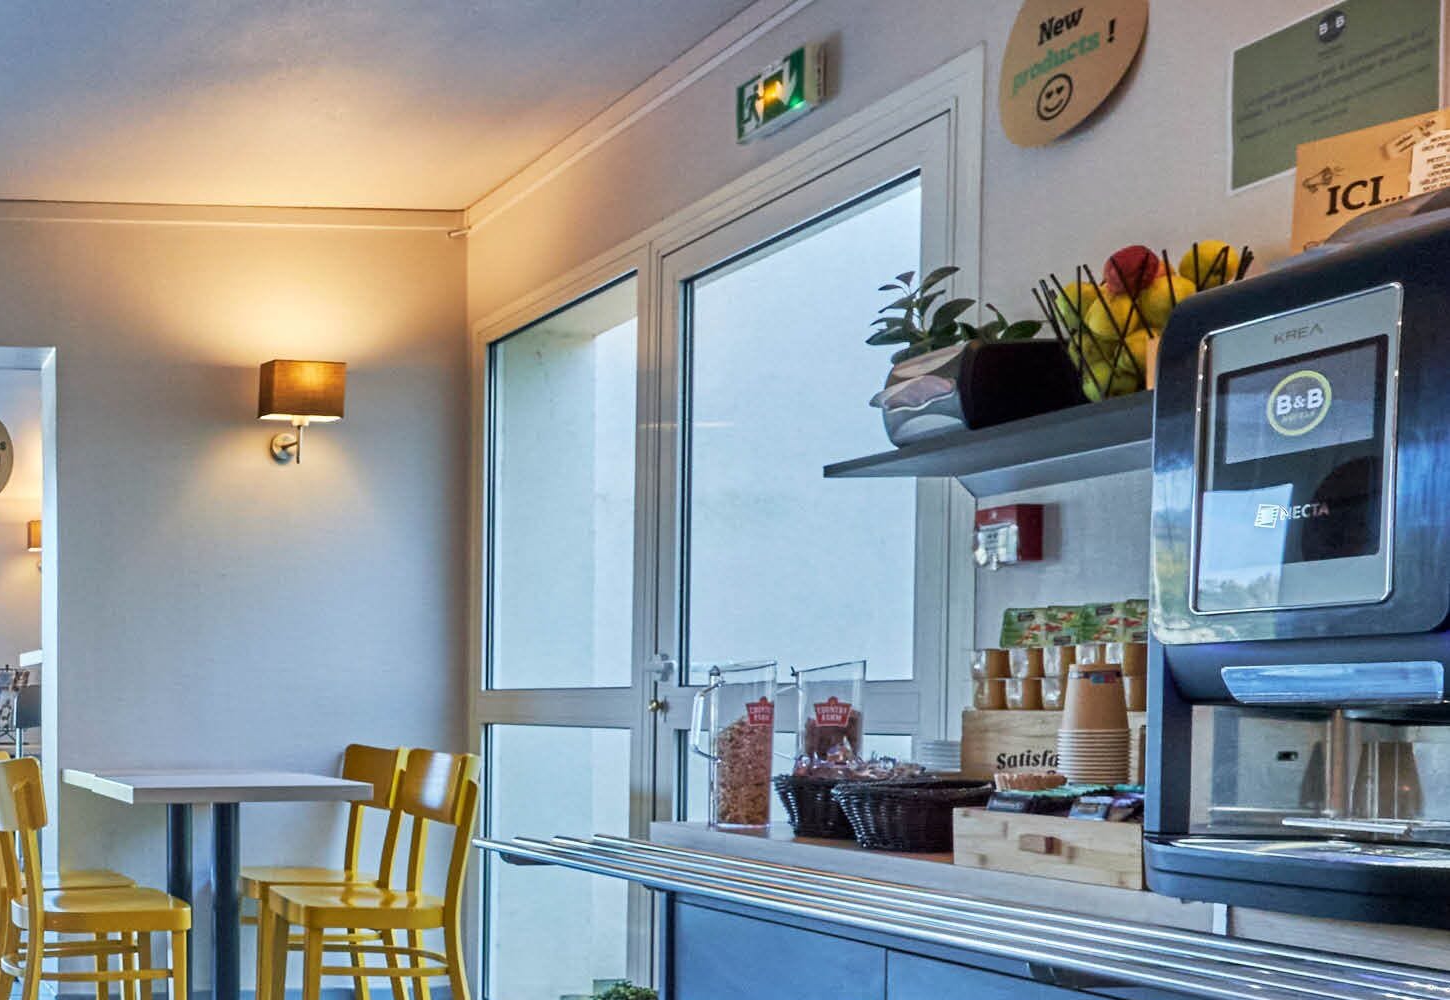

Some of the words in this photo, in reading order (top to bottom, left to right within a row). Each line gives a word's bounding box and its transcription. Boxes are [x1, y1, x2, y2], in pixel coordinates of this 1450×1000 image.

[1038, 7, 1084, 46] New
[1013, 31, 1101, 97] products
[1326, 175, 1403, 216] ICI...
[1274, 322, 1324, 345] KREA
[1275, 387, 1324, 416] B&B
